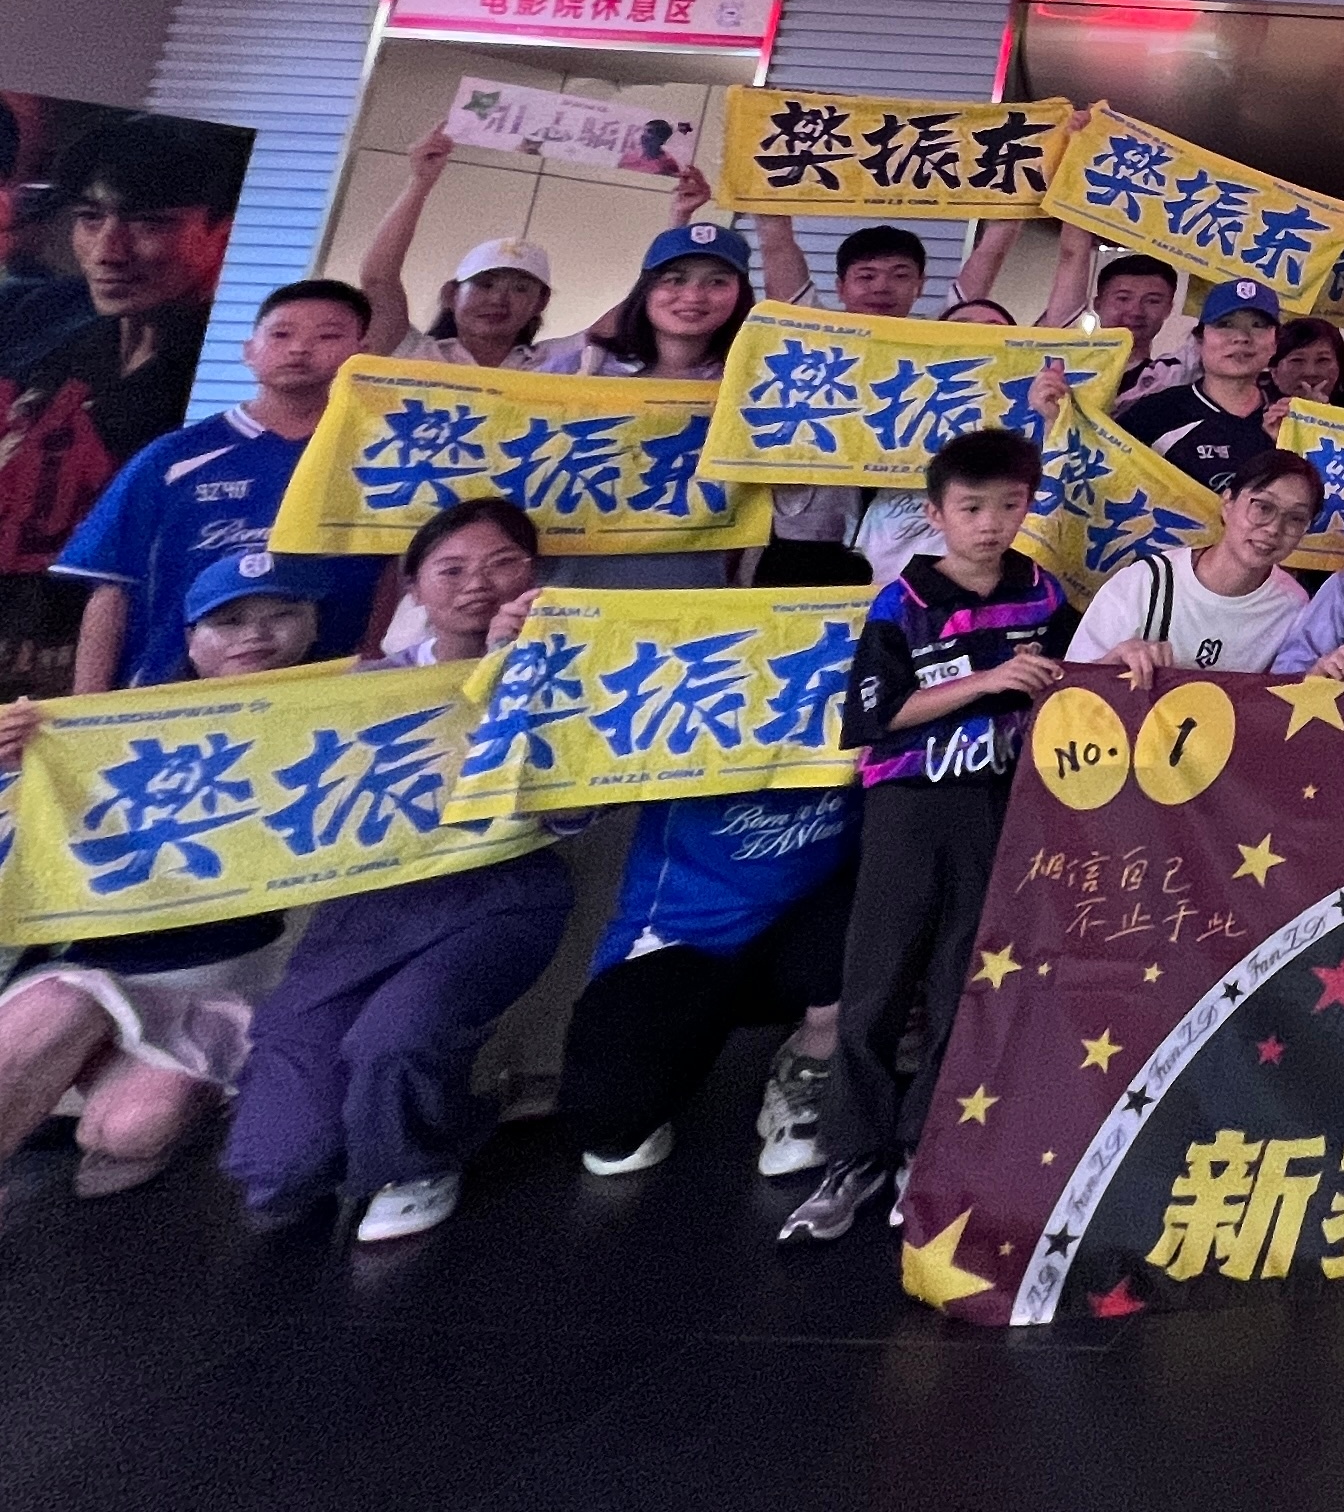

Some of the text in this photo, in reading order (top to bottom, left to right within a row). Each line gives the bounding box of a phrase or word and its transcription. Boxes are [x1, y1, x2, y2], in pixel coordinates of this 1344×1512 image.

[753, 100, 1057, 195] 樊振东
[1084, 133, 1331, 287] 樊振东
[352, 398, 728, 517] 樊振东
[458, 621, 860, 777] 樊振东
[1168, 717, 1197, 768] 1
[69, 703, 494, 896] 樊振
[711, 803, 790, 836] Born
[1014, 845, 1195, 895] 相信自己
[1065, 897, 1247, 943] 不止于此
